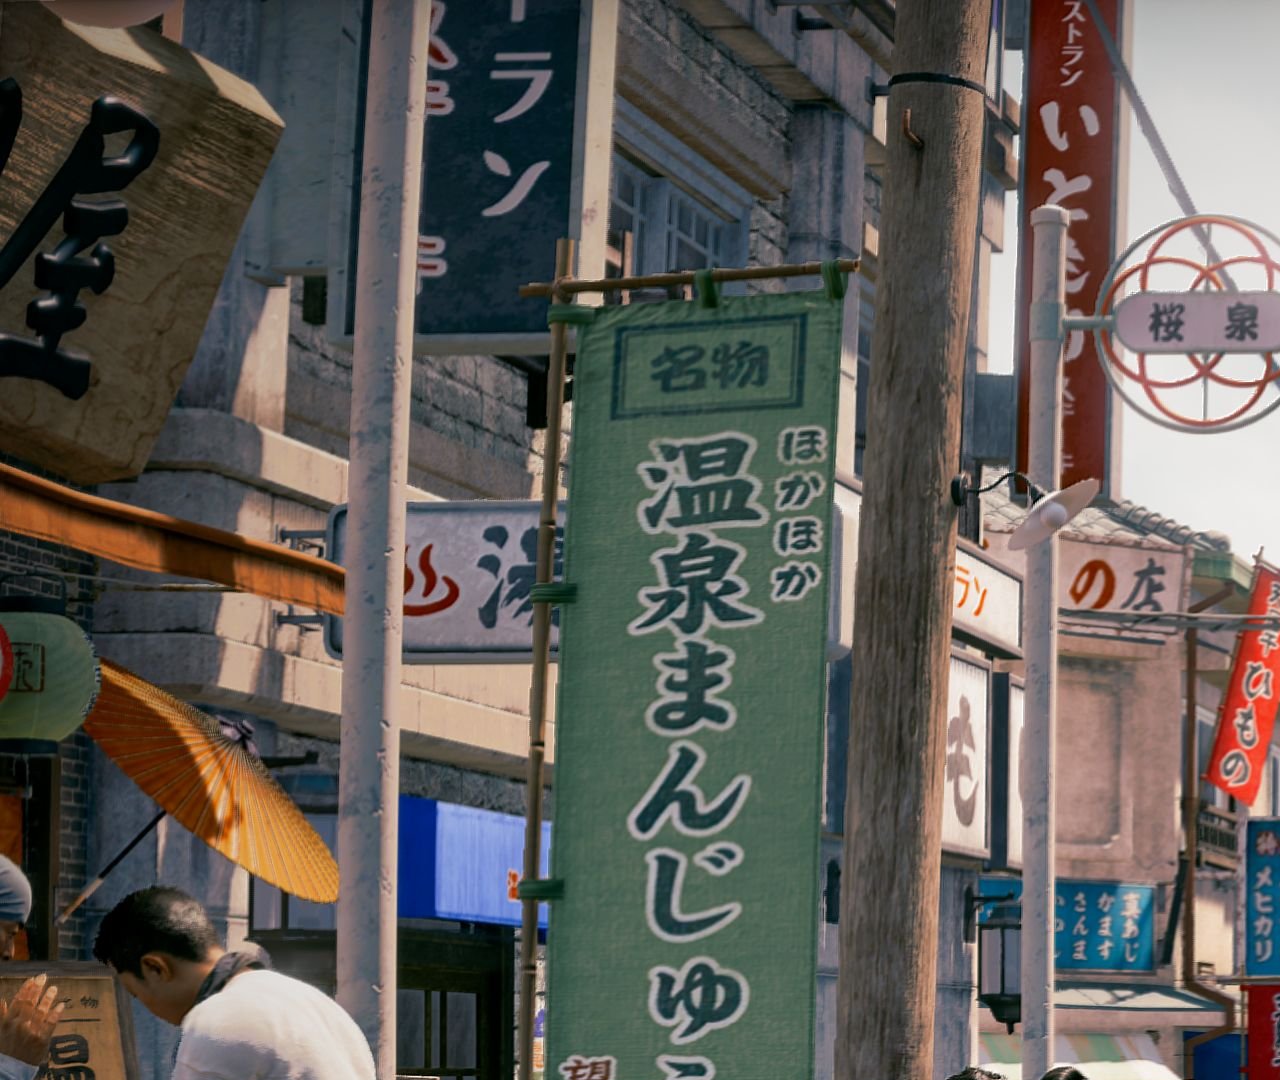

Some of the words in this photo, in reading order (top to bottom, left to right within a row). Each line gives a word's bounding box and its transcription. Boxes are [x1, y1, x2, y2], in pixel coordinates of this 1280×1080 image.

[481, 0, 552, 217] ラン
[650, 343, 768, 394] 名物
[1149, 303, 1260, 343] 桜泉
[772, 428, 827, 602] ほかほか
[1220, 660, 1273, 787] ひもの
[1072, 892, 1089, 960] さんま
[1254, 866, 1274, 963] メヒカリ
